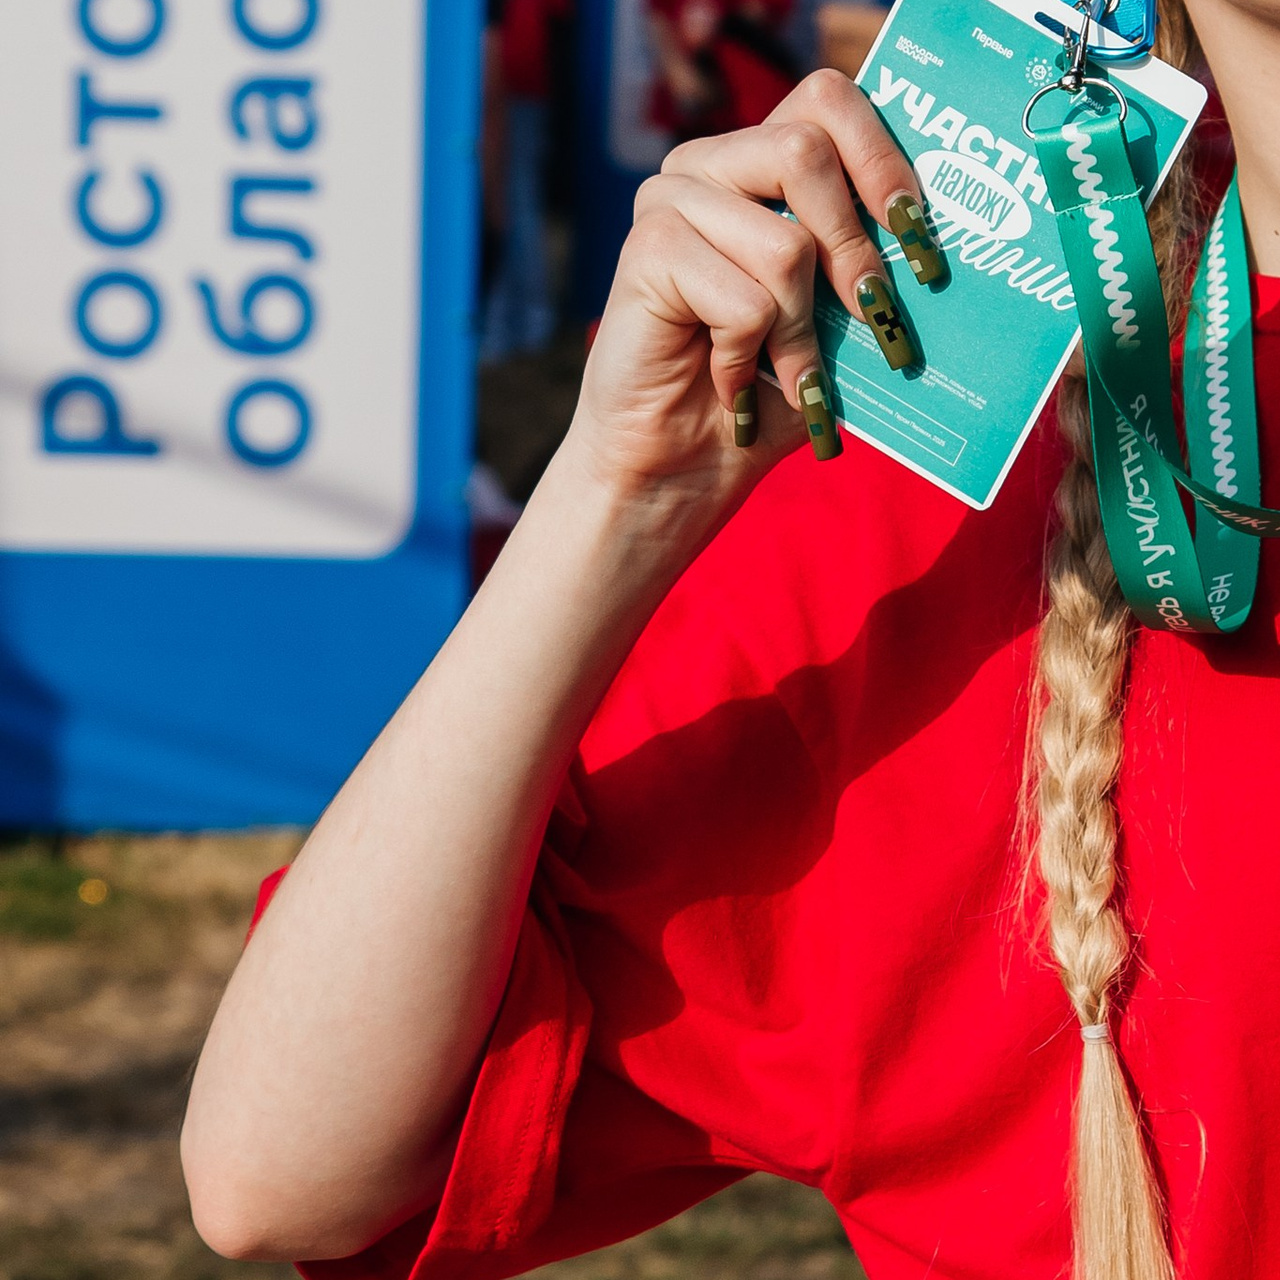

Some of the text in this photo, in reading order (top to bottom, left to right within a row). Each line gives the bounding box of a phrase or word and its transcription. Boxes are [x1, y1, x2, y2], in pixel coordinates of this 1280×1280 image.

[971, 26, 1014, 59] Первые
[869, 65, 1056, 214] УЧАСТН
[929, 159, 1016, 233] нахожу
[1116, 413, 1176, 566] участни
